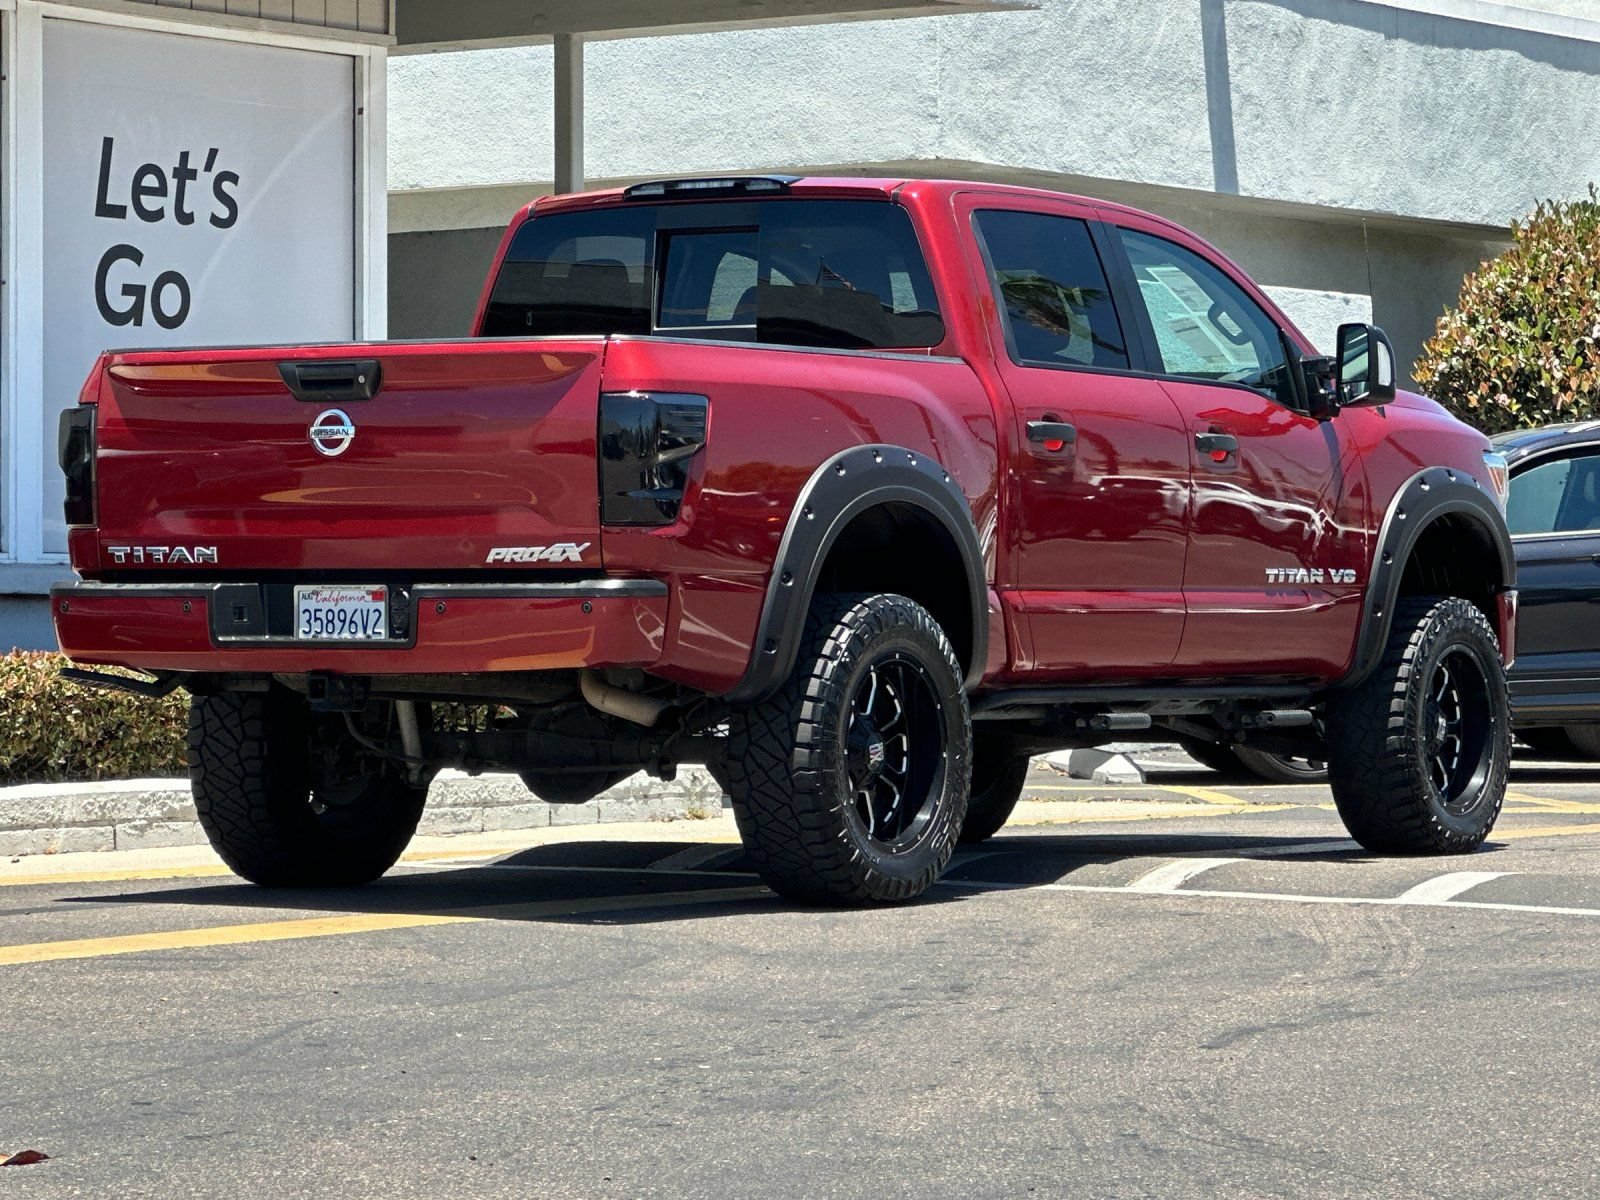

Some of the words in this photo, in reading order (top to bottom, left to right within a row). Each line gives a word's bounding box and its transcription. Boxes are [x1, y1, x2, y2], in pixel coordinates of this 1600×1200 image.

[95, 137, 239, 229] Let's
[95, 244, 191, 329] Go
[313, 428, 349, 436] NISSAN
[108, 546, 218, 563] TITAN
[1265, 567, 1324, 584] TITAN
[314, 590, 367, 607] California
[302, 608, 382, 635] 35896V2
